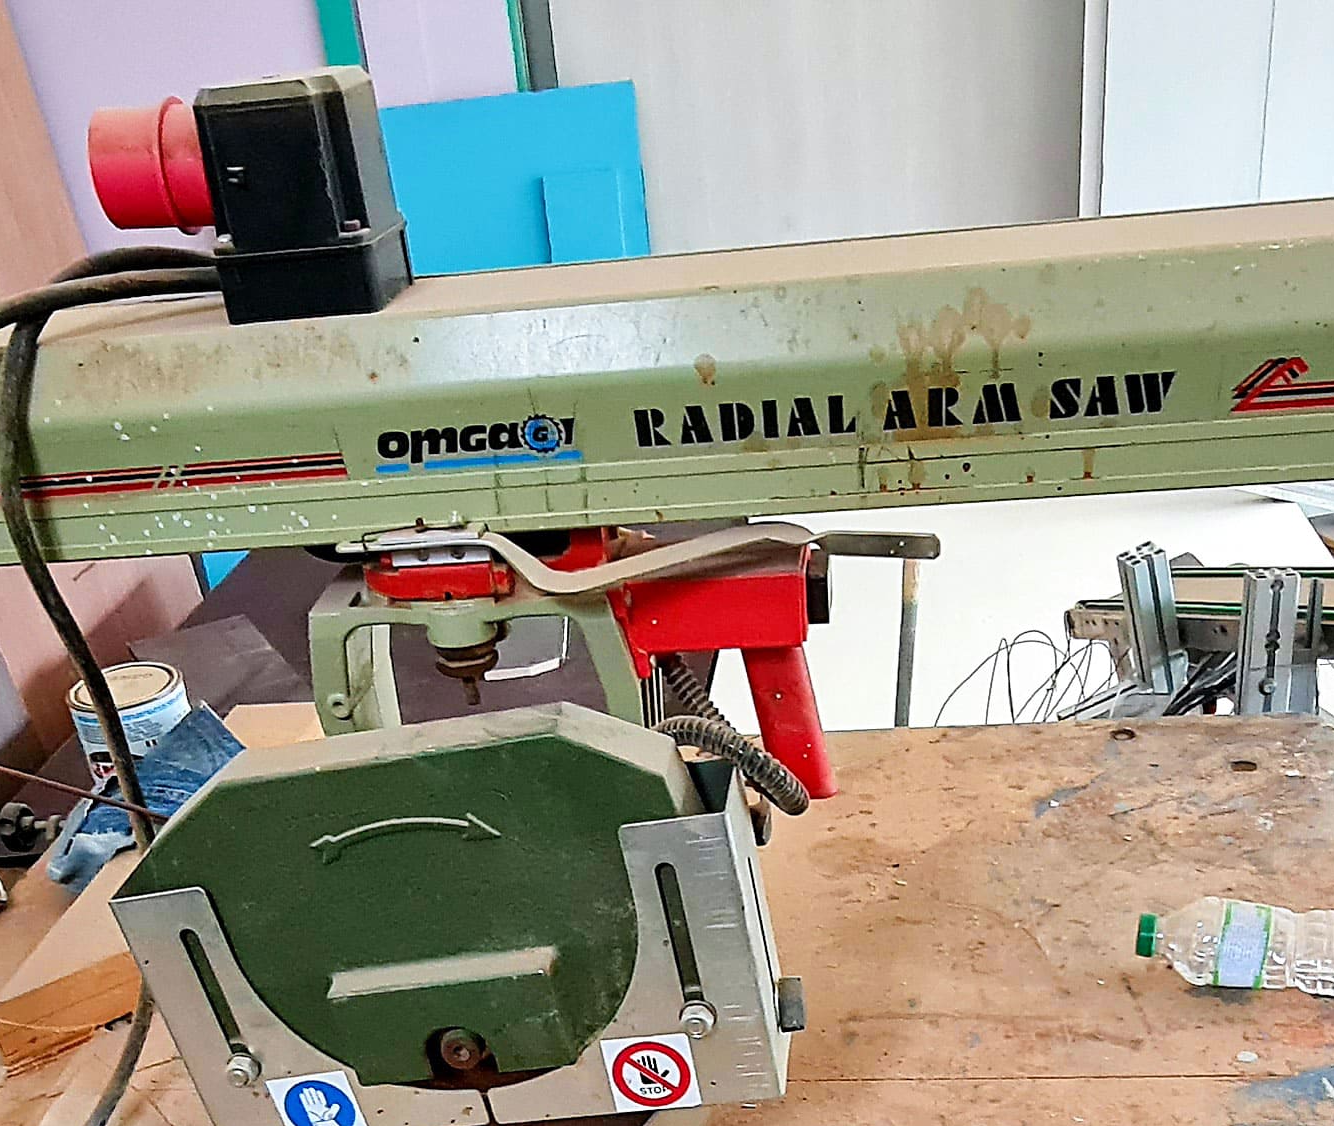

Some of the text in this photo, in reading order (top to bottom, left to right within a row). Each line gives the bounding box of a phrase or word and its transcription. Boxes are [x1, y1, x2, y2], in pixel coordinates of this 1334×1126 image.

[633, 370, 1177, 447] RADIAL ARM SAW
